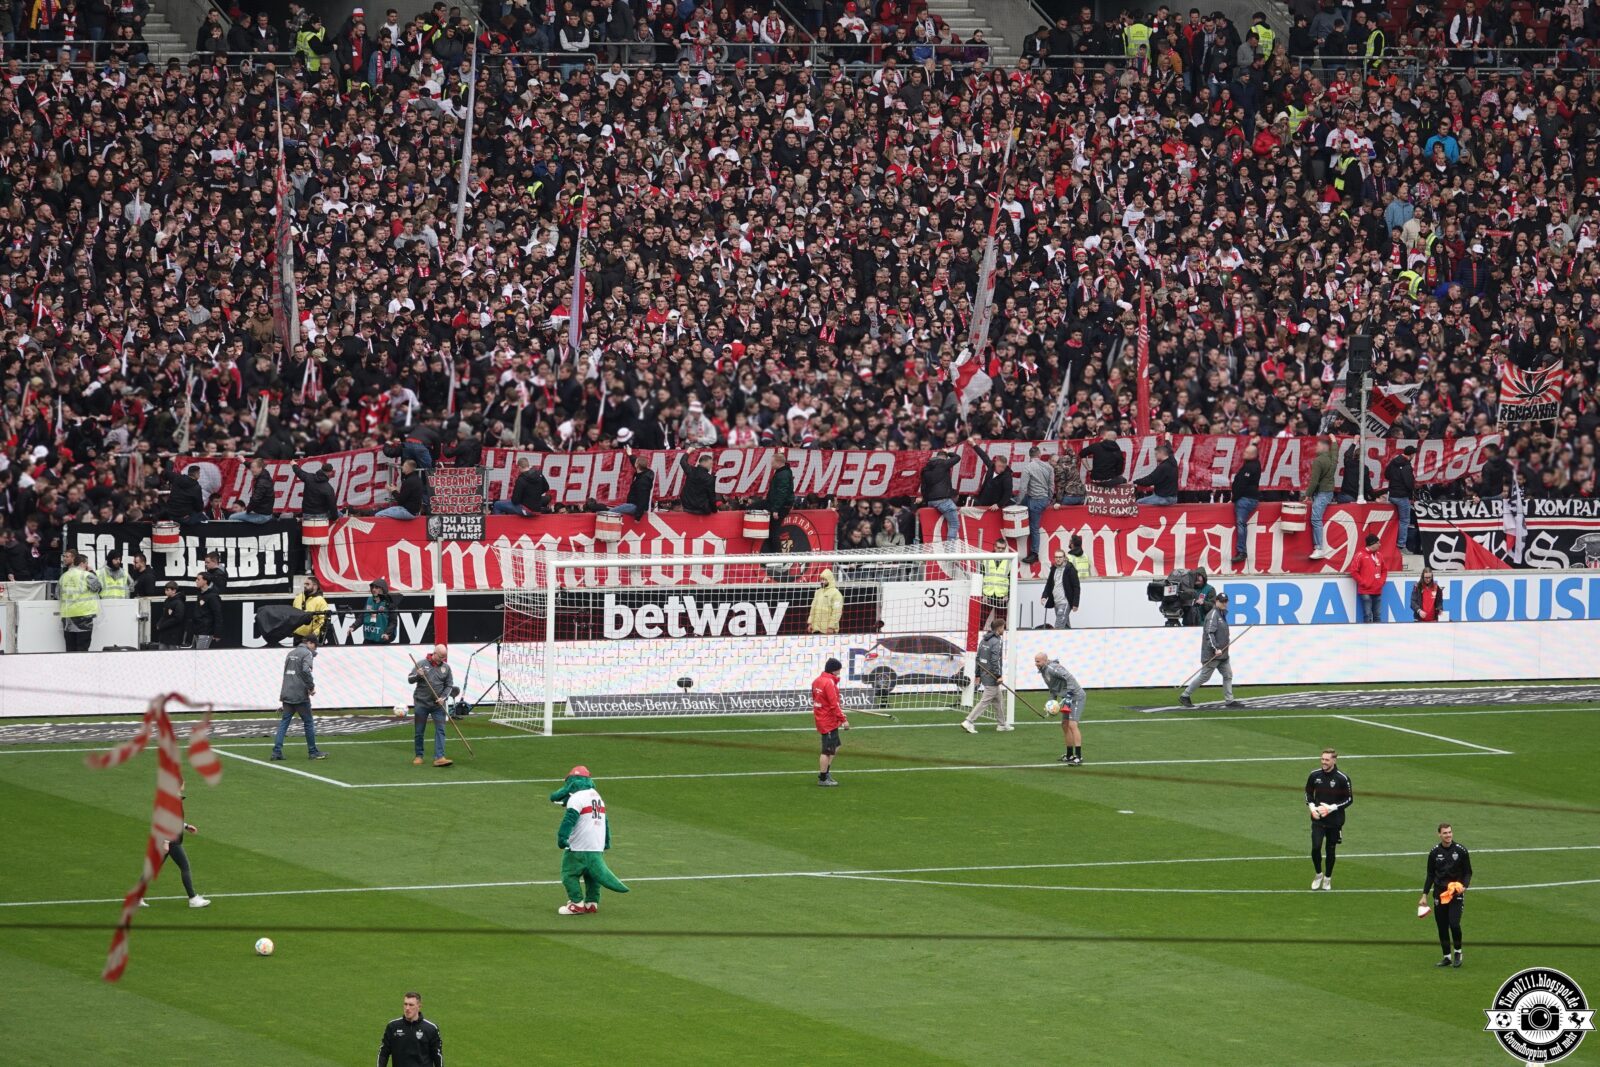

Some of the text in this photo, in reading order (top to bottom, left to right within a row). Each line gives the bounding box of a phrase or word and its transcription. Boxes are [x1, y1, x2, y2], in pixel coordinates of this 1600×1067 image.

[1085, 484, 1118, 496] ULTRA
[442, 516, 482, 524] DU BIST
[442, 524, 482, 533] IMMER
[442, 532, 458, 540] BEI
[1320, 508, 1395, 574] 97
[317, 511, 726, 591] Commando
[924, 588, 950, 608] 35
[1223, 577, 1600, 625] BRANHOUS
[603, 593, 790, 640] betway
[576, 696, 719, 713] Mercedes-Benz Bank
[729, 693, 814, 709] Mercedes-Be
